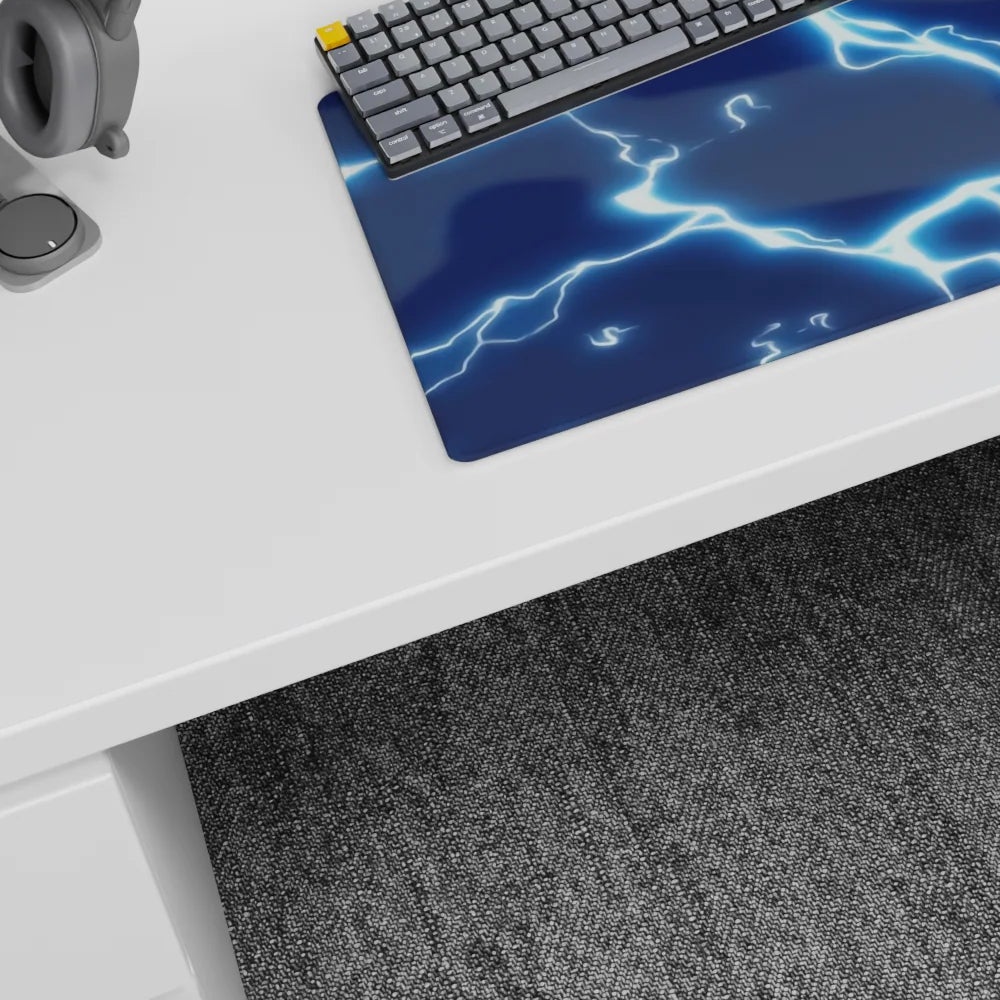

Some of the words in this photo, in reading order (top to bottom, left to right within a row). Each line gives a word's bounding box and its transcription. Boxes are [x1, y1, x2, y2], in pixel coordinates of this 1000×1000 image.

[394, 107, 408, 116] shift
[463, 102, 492, 117] command
[428, 119, 448, 131] option
[388, 134, 409, 146] control
